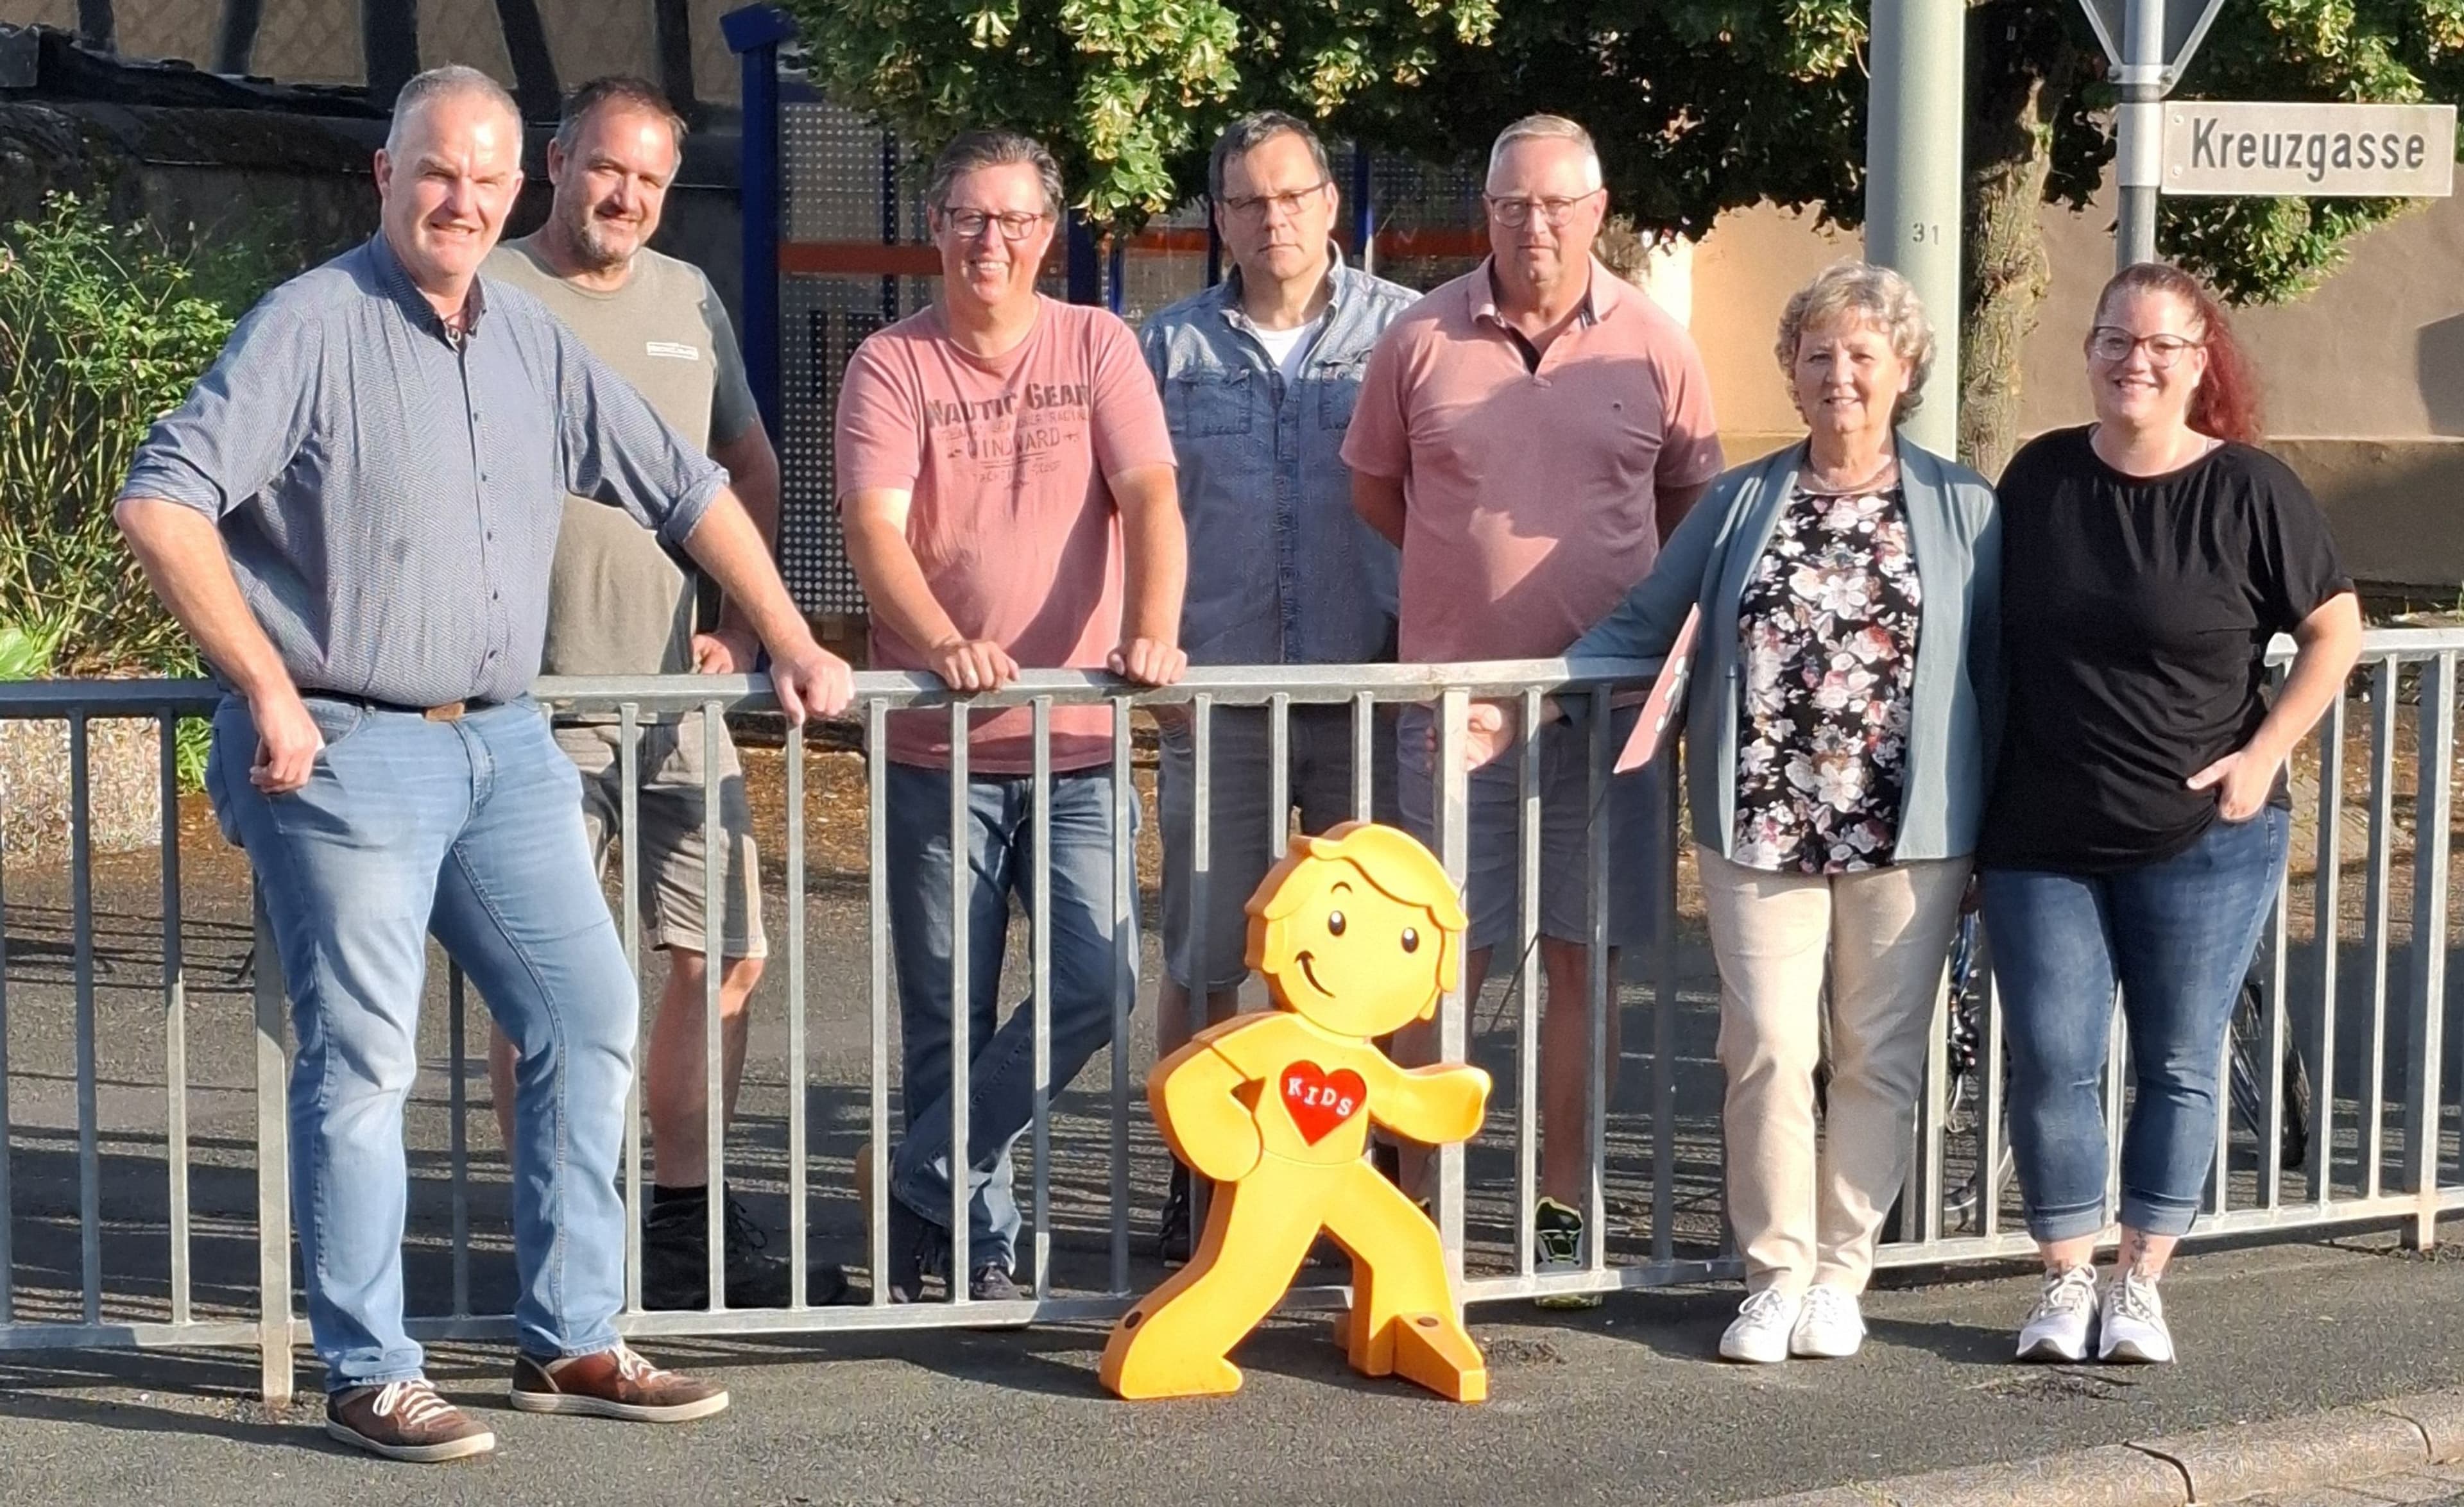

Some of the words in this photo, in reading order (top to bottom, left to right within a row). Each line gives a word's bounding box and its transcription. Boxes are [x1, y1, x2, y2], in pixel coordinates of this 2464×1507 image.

[2191, 117, 2425, 183] Kreuzgasse
[1912, 222, 1939, 245] 31
[1287, 1077, 1353, 1116] KIDS
